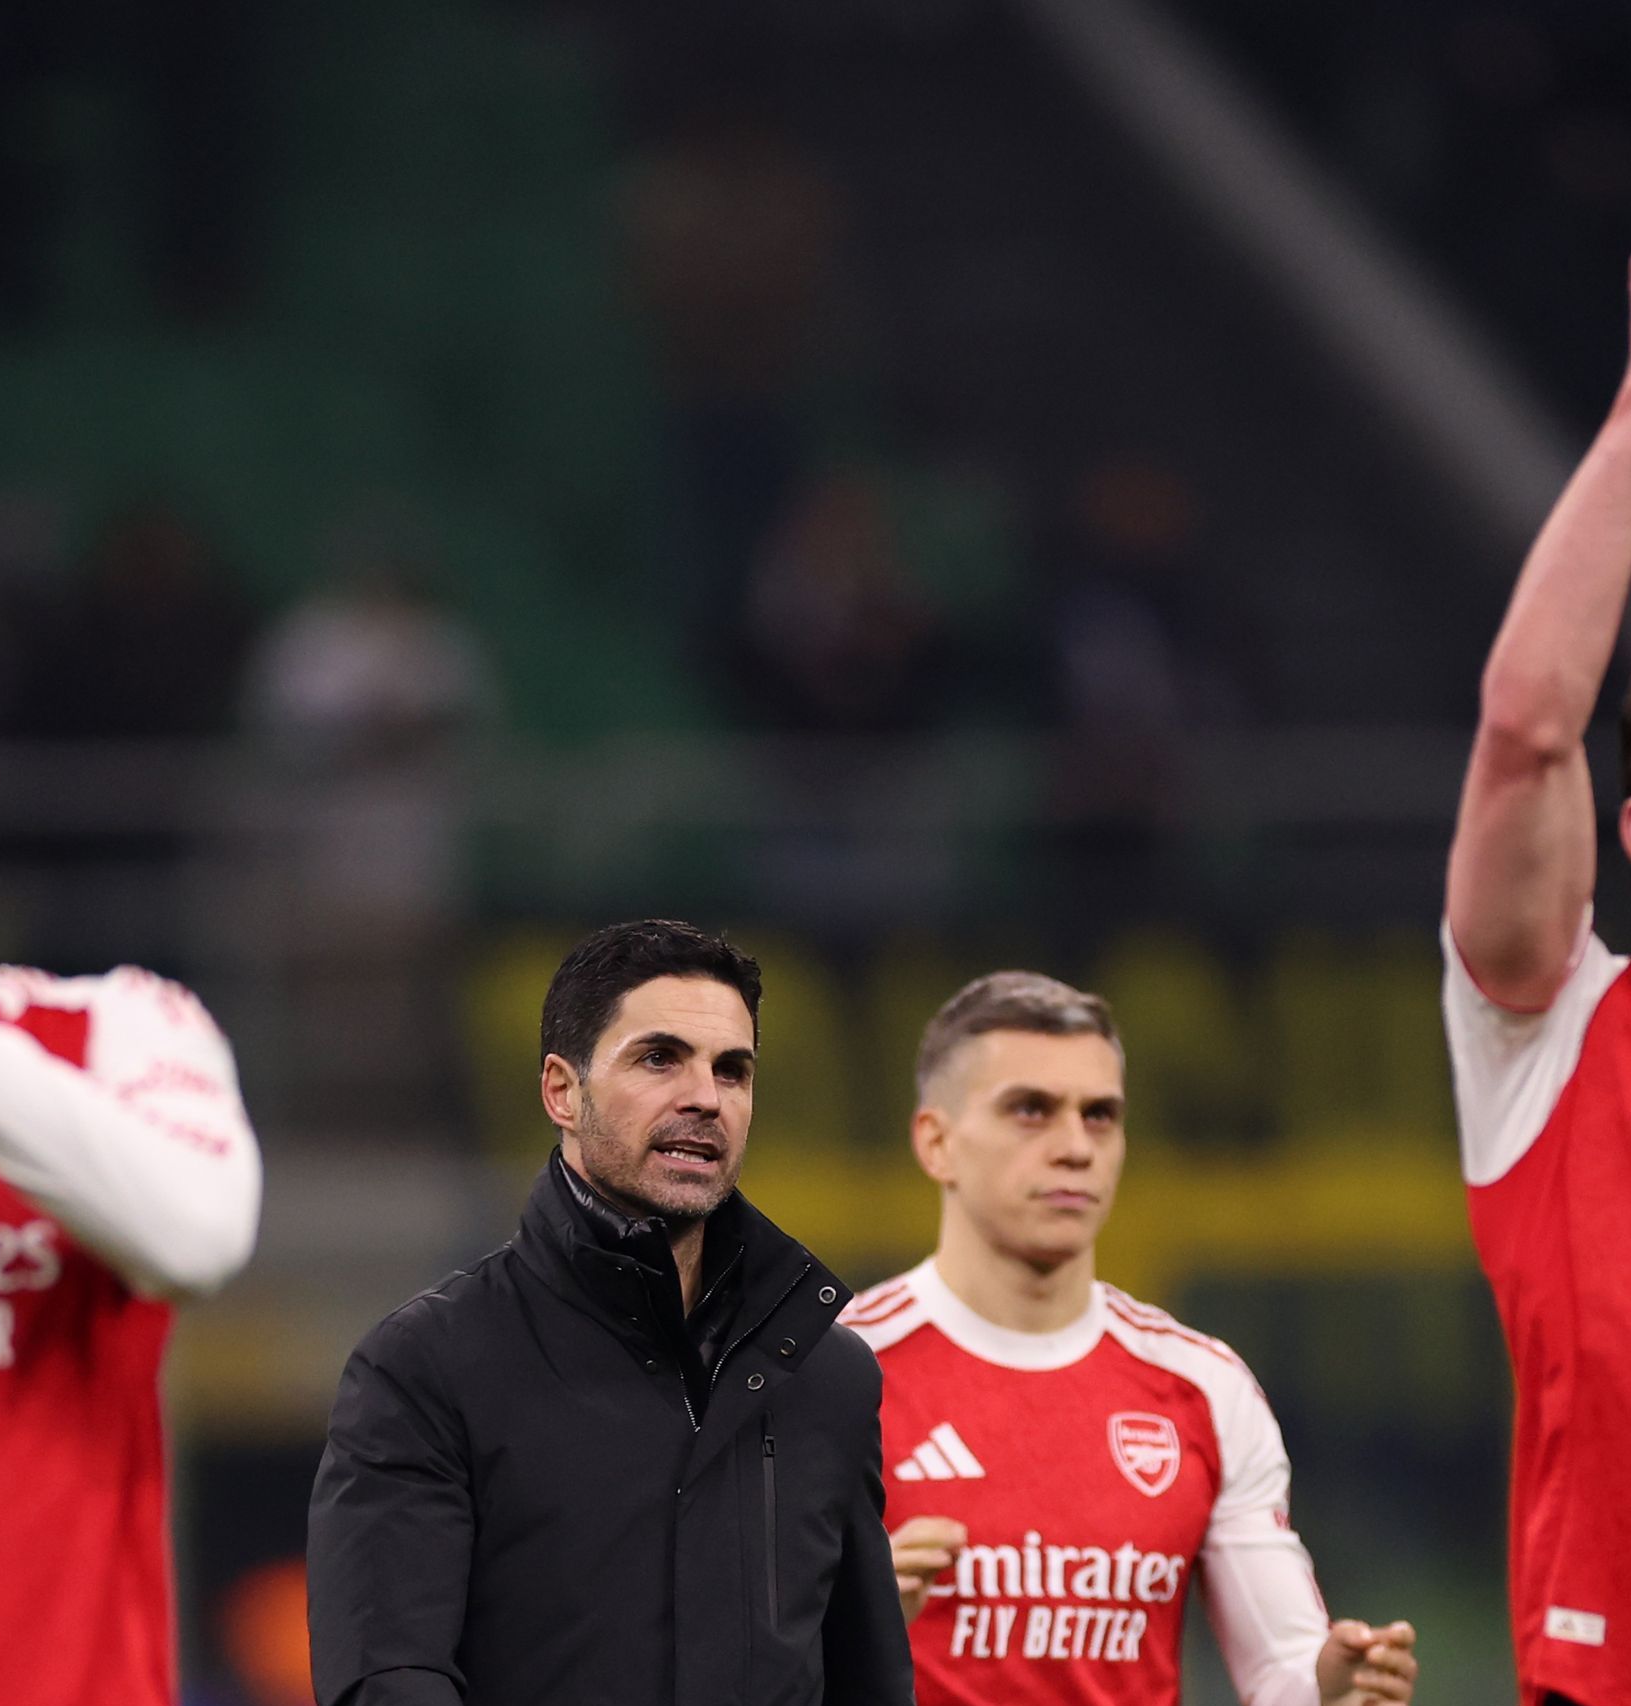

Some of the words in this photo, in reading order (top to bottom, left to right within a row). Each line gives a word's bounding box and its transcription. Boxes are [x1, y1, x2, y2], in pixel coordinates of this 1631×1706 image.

[928, 1529, 1186, 1604] mirates
[950, 1604, 1018, 1660] FLY
[1023, 1605, 1148, 1663] BETTER
